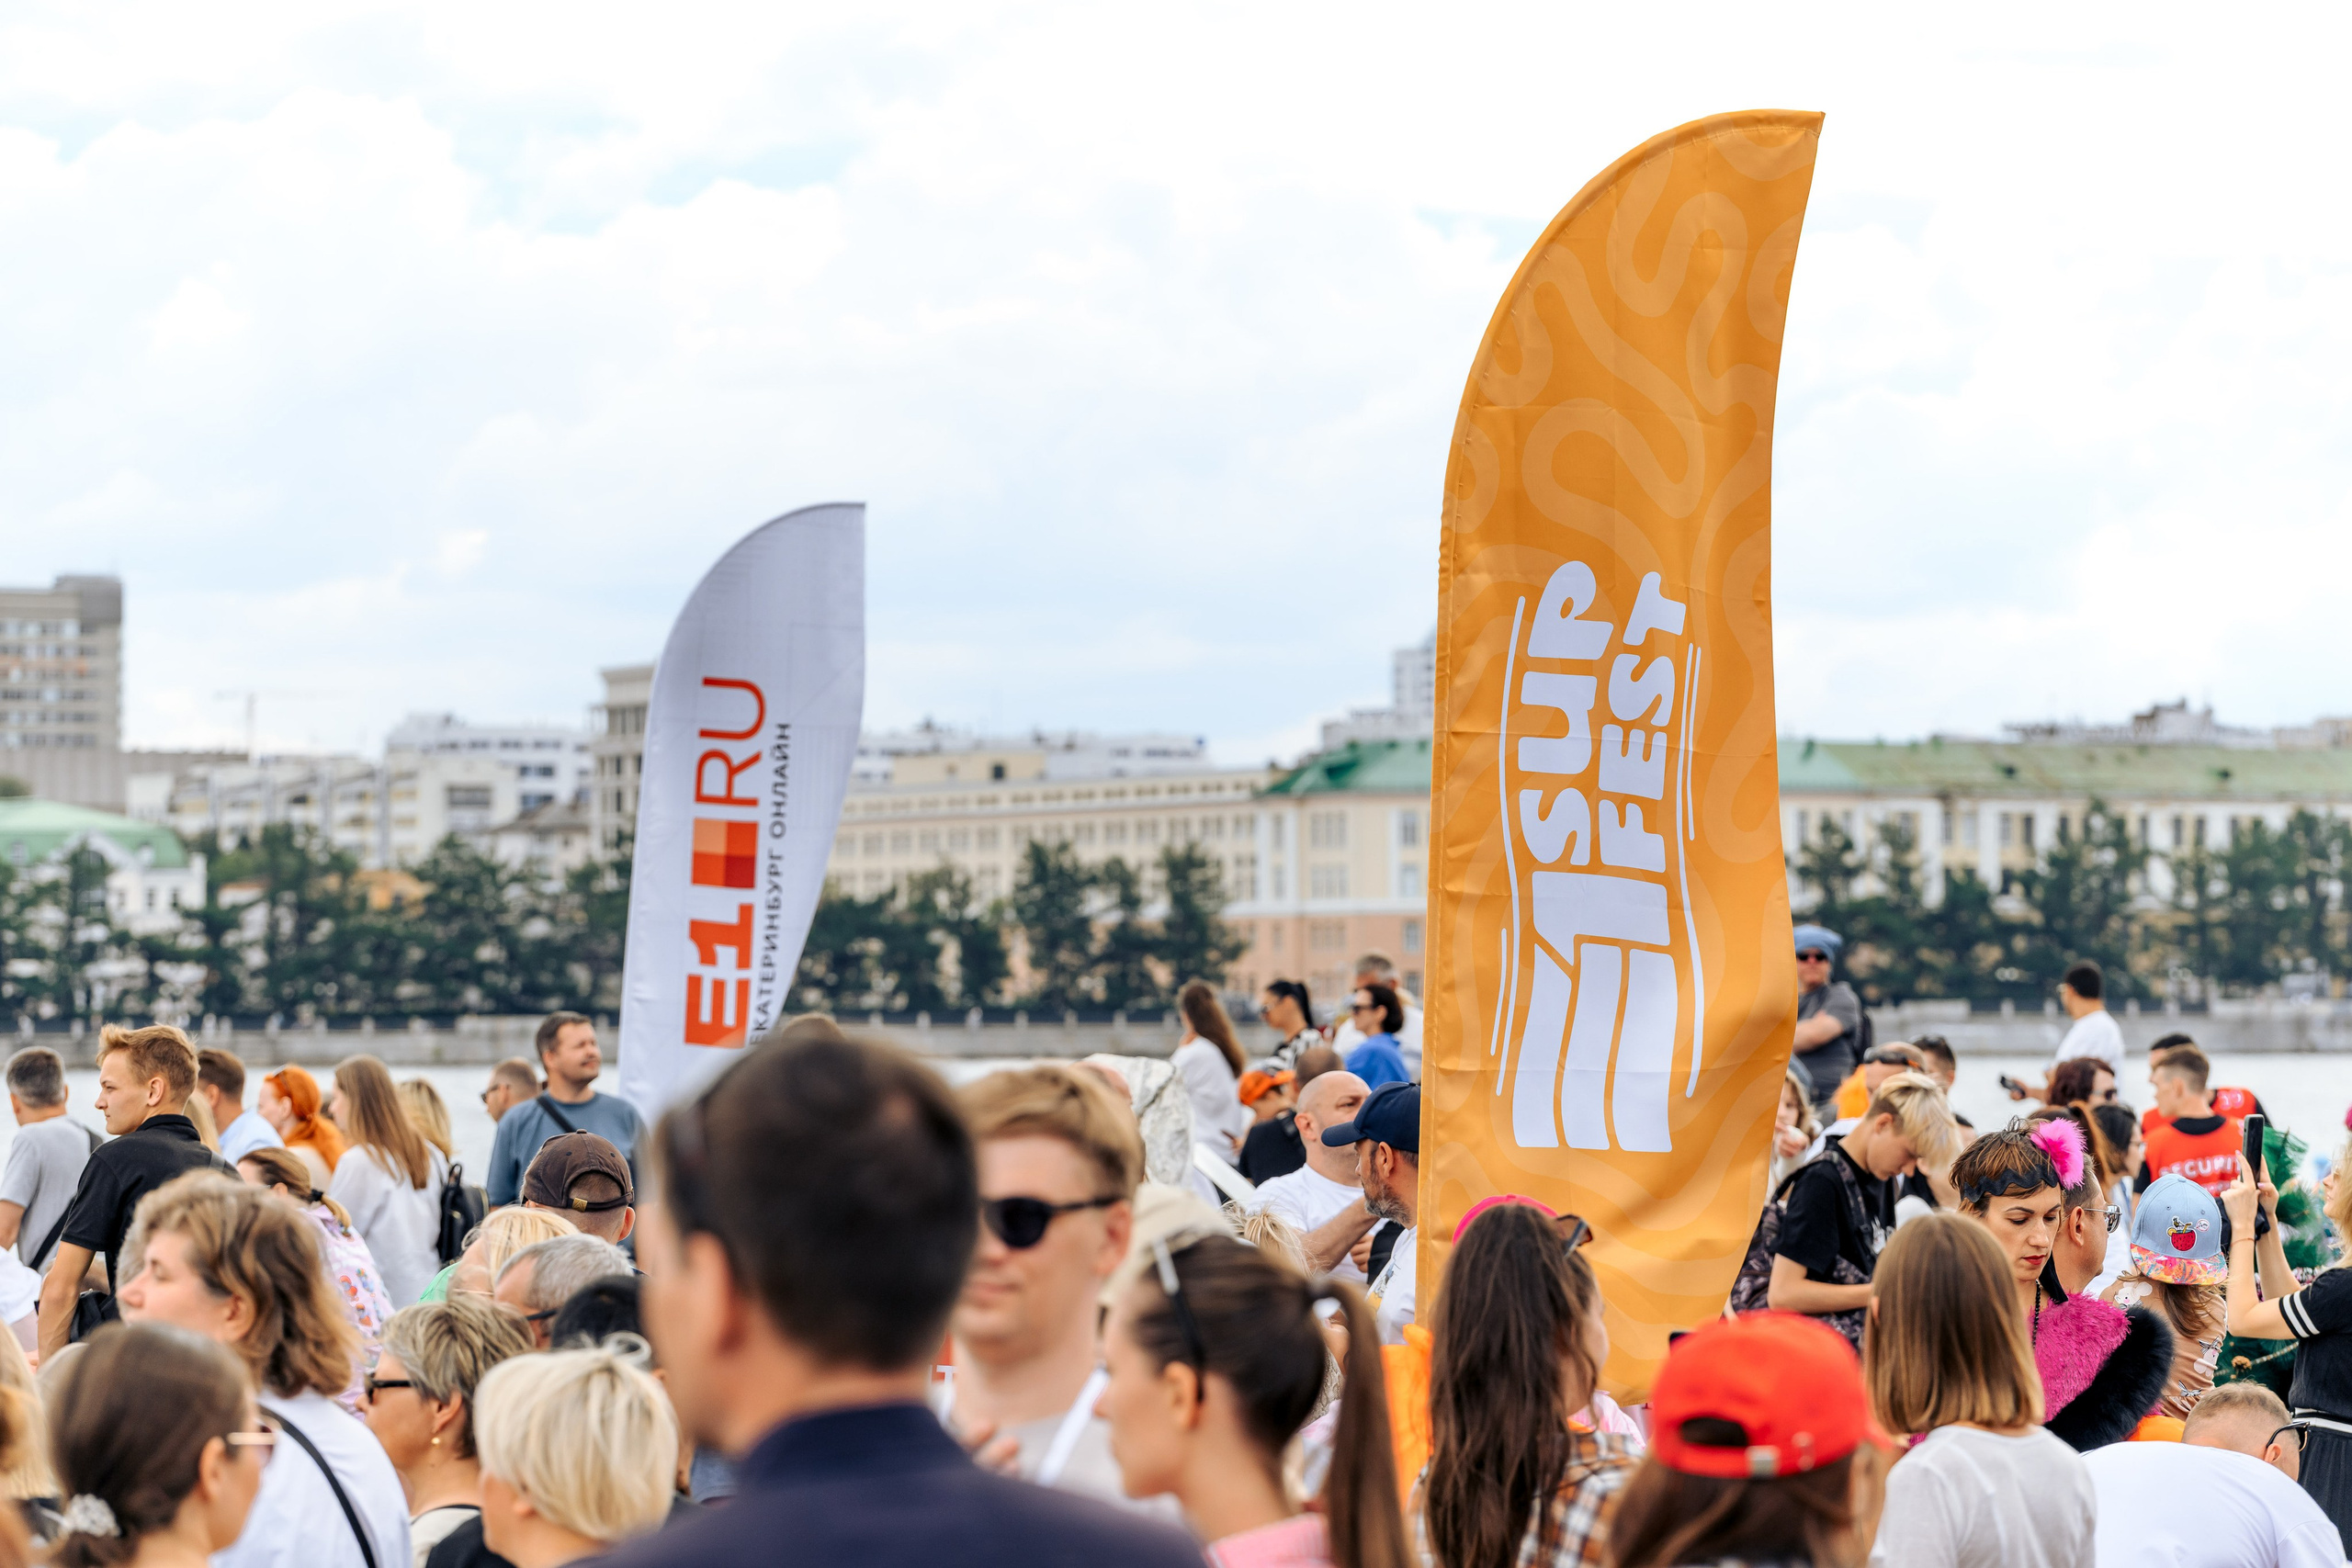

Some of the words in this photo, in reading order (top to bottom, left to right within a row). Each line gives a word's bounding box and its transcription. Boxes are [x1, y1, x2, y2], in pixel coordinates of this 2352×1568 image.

[695, 676, 766, 807] RU
[769, 722, 792, 840] ОНЛАЙН
[1518, 560, 1613, 866] SUP
[1599, 571, 1686, 873] FEST
[684, 903, 753, 1049] E1
